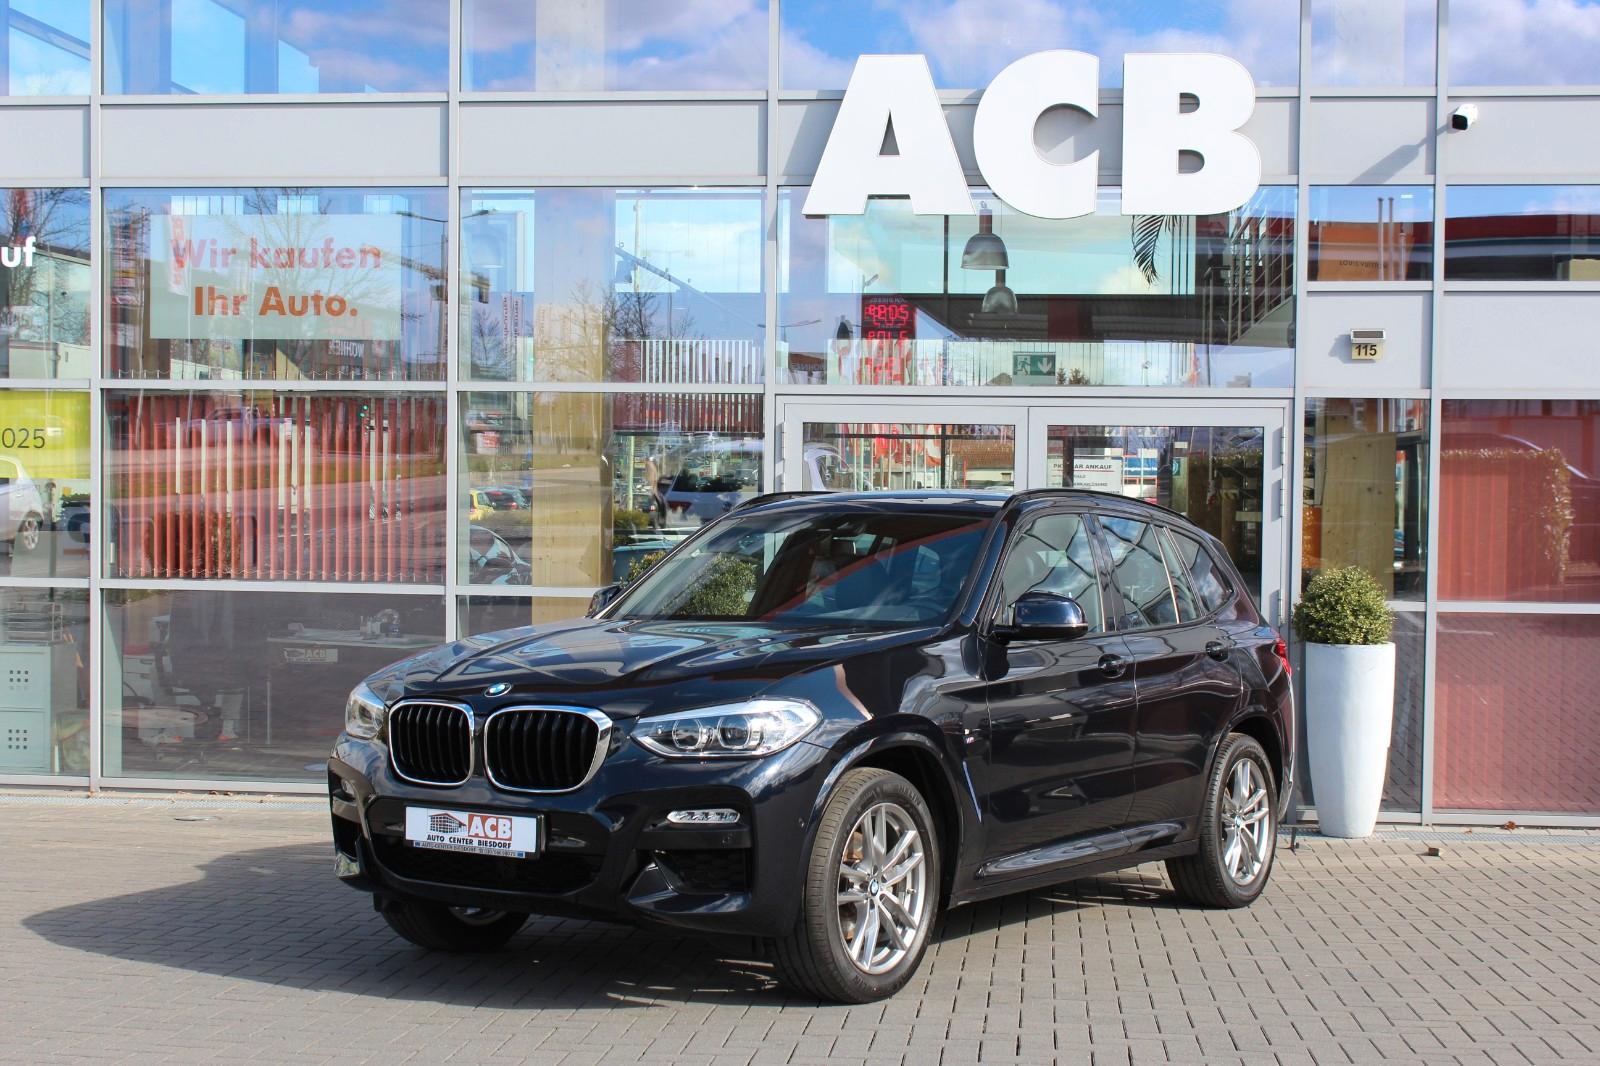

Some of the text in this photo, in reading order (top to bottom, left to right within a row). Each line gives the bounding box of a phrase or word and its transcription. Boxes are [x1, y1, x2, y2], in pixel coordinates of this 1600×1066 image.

[801, 48, 1262, 220] ACB
[171, 237, 382, 269] Wir kaufen
[194, 286, 359, 317] Ihr Auto.
[1355, 344, 1377, 356] 115
[1, 427, 47, 449] 025
[470, 816, 511, 839] ACB
[426, 834, 512, 850] AUTO CENTER BIESDORF
